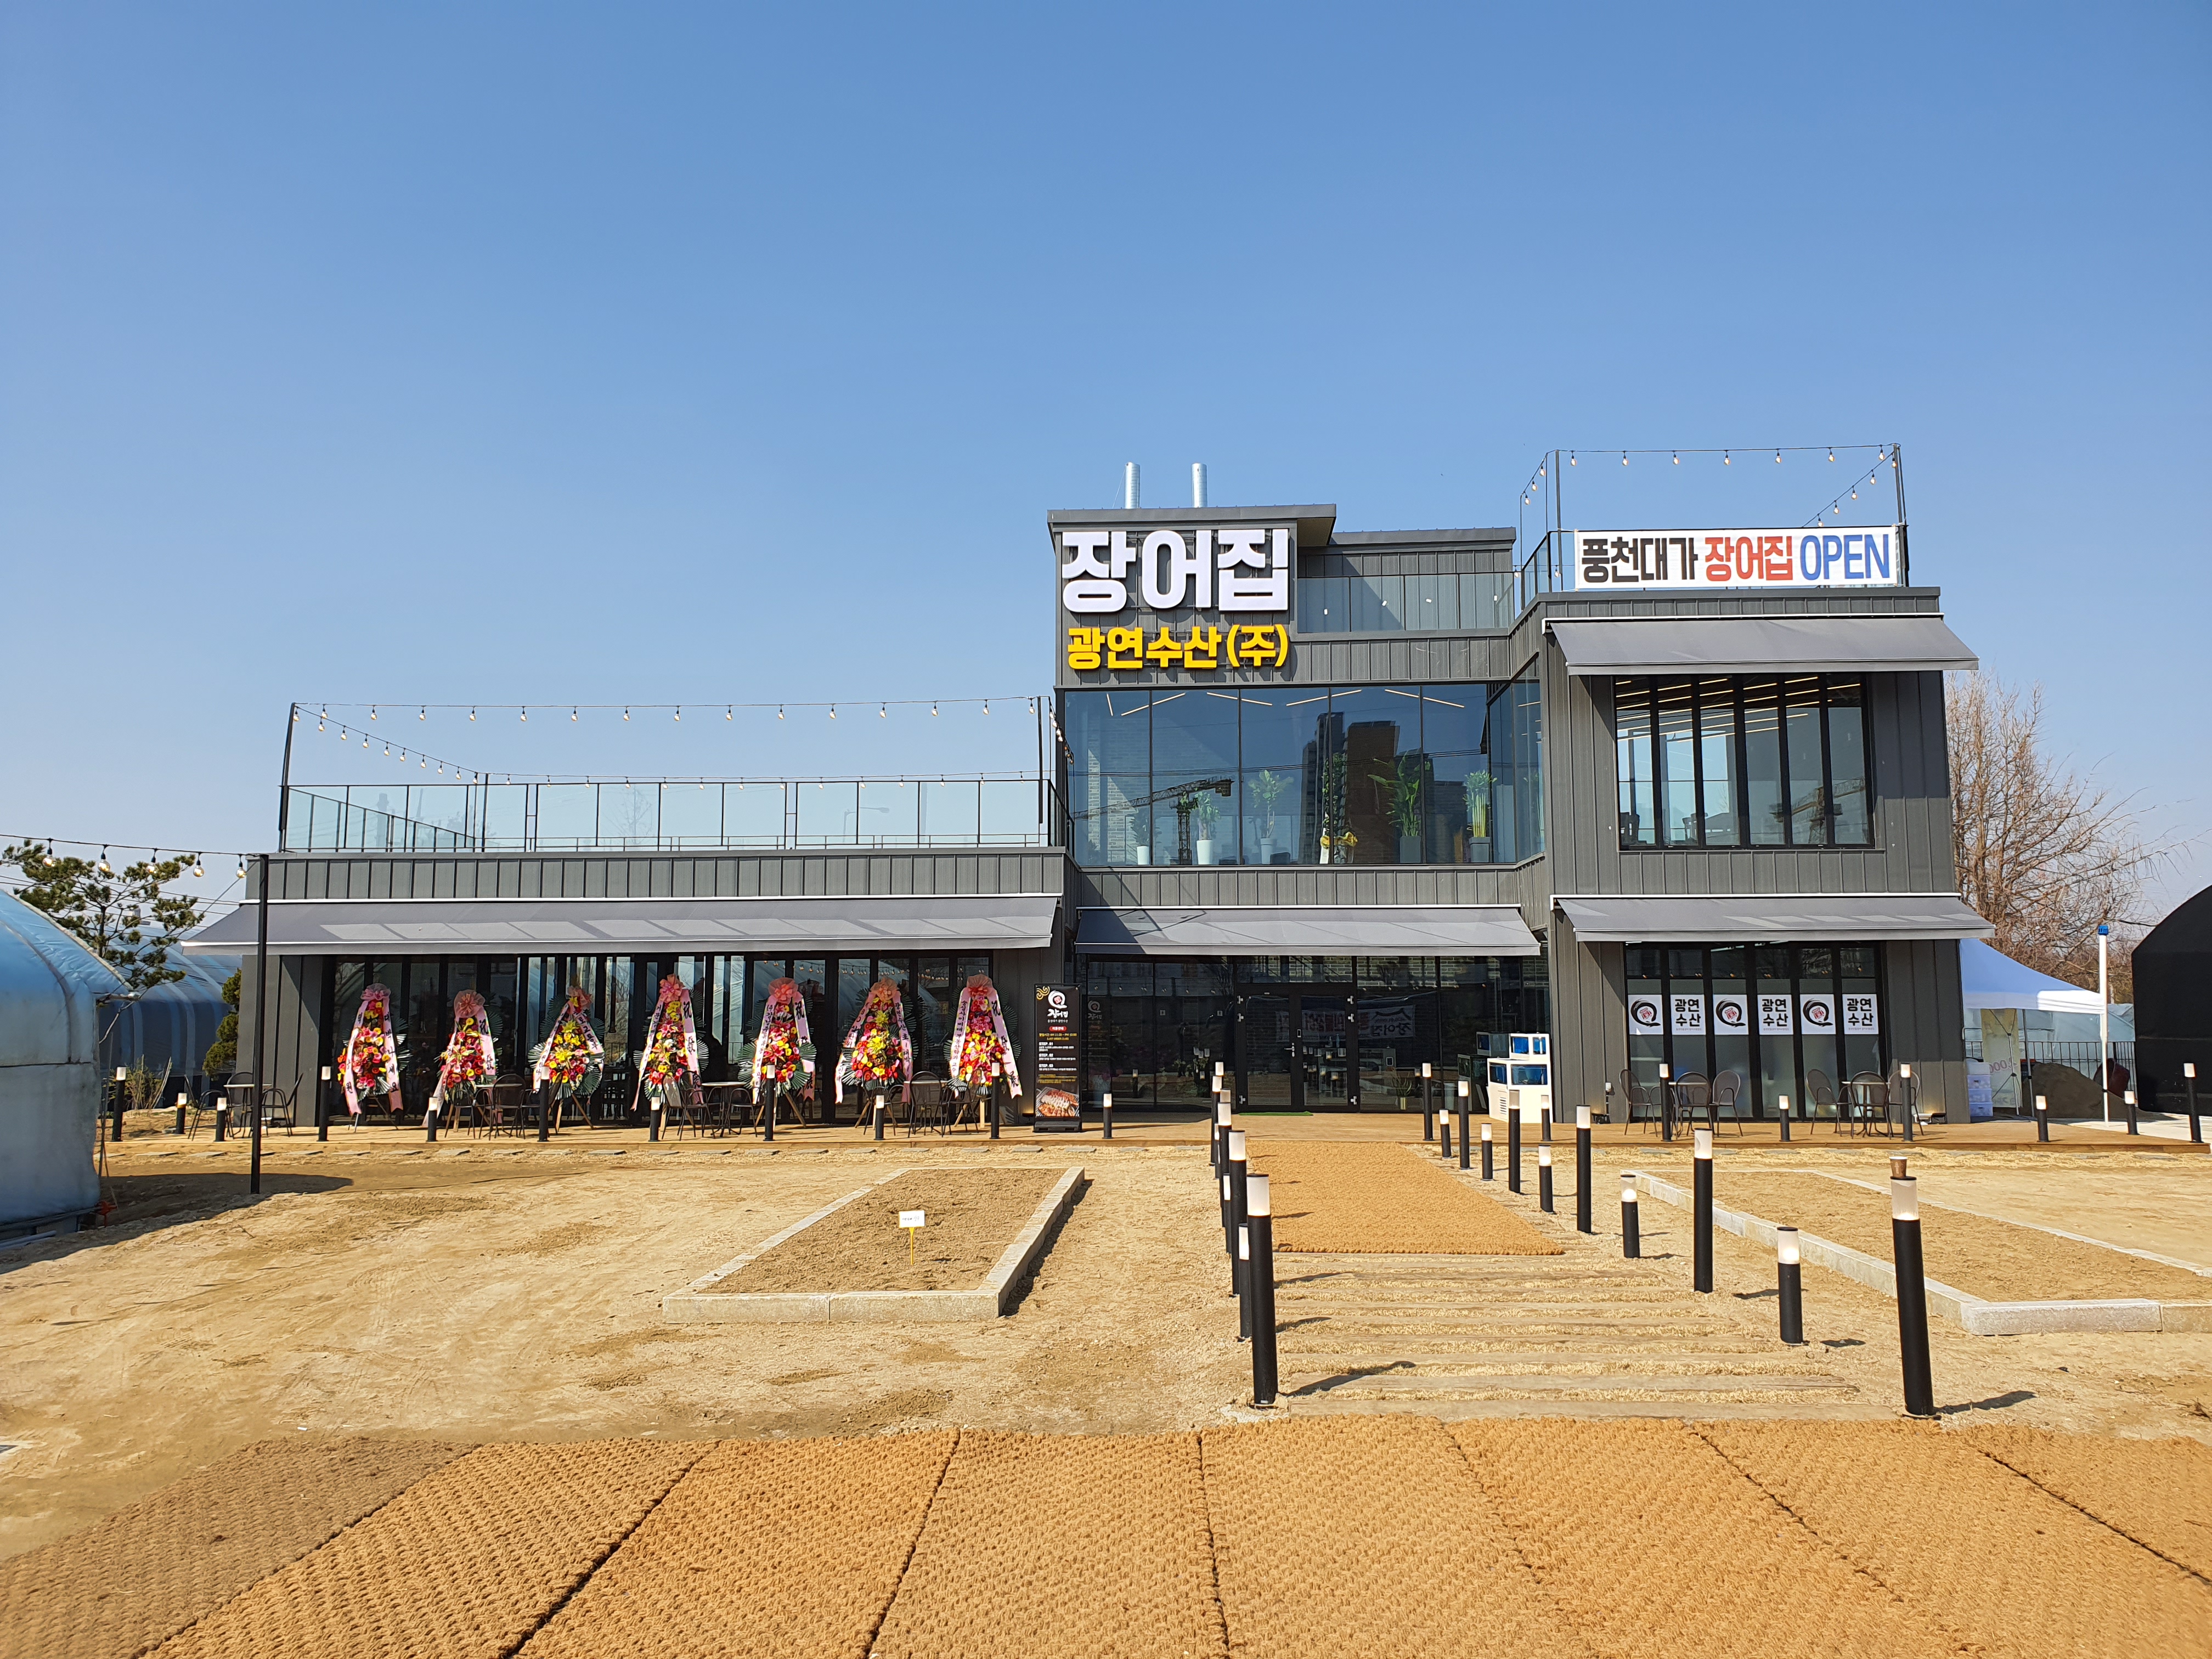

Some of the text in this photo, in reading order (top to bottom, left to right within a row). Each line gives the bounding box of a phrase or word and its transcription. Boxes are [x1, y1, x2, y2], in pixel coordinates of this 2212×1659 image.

[1582, 534, 1889, 583] 풍천대가 장어집 OPEN
[1062, 529, 1289, 612] 장어집
[1068, 624, 1288, 669] 광연수산(주)
[1675, 999, 1699, 1012] 광연
[1762, 999, 1786, 1012] 광연
[1847, 998, 1871, 1011] 광연
[1047, 1008, 1068, 1018] 장어집
[1848, 1013, 1874, 1026] 수산
[1676, 1014, 1701, 1026] 수산
[1763, 1014, 1788, 1026] 수산
